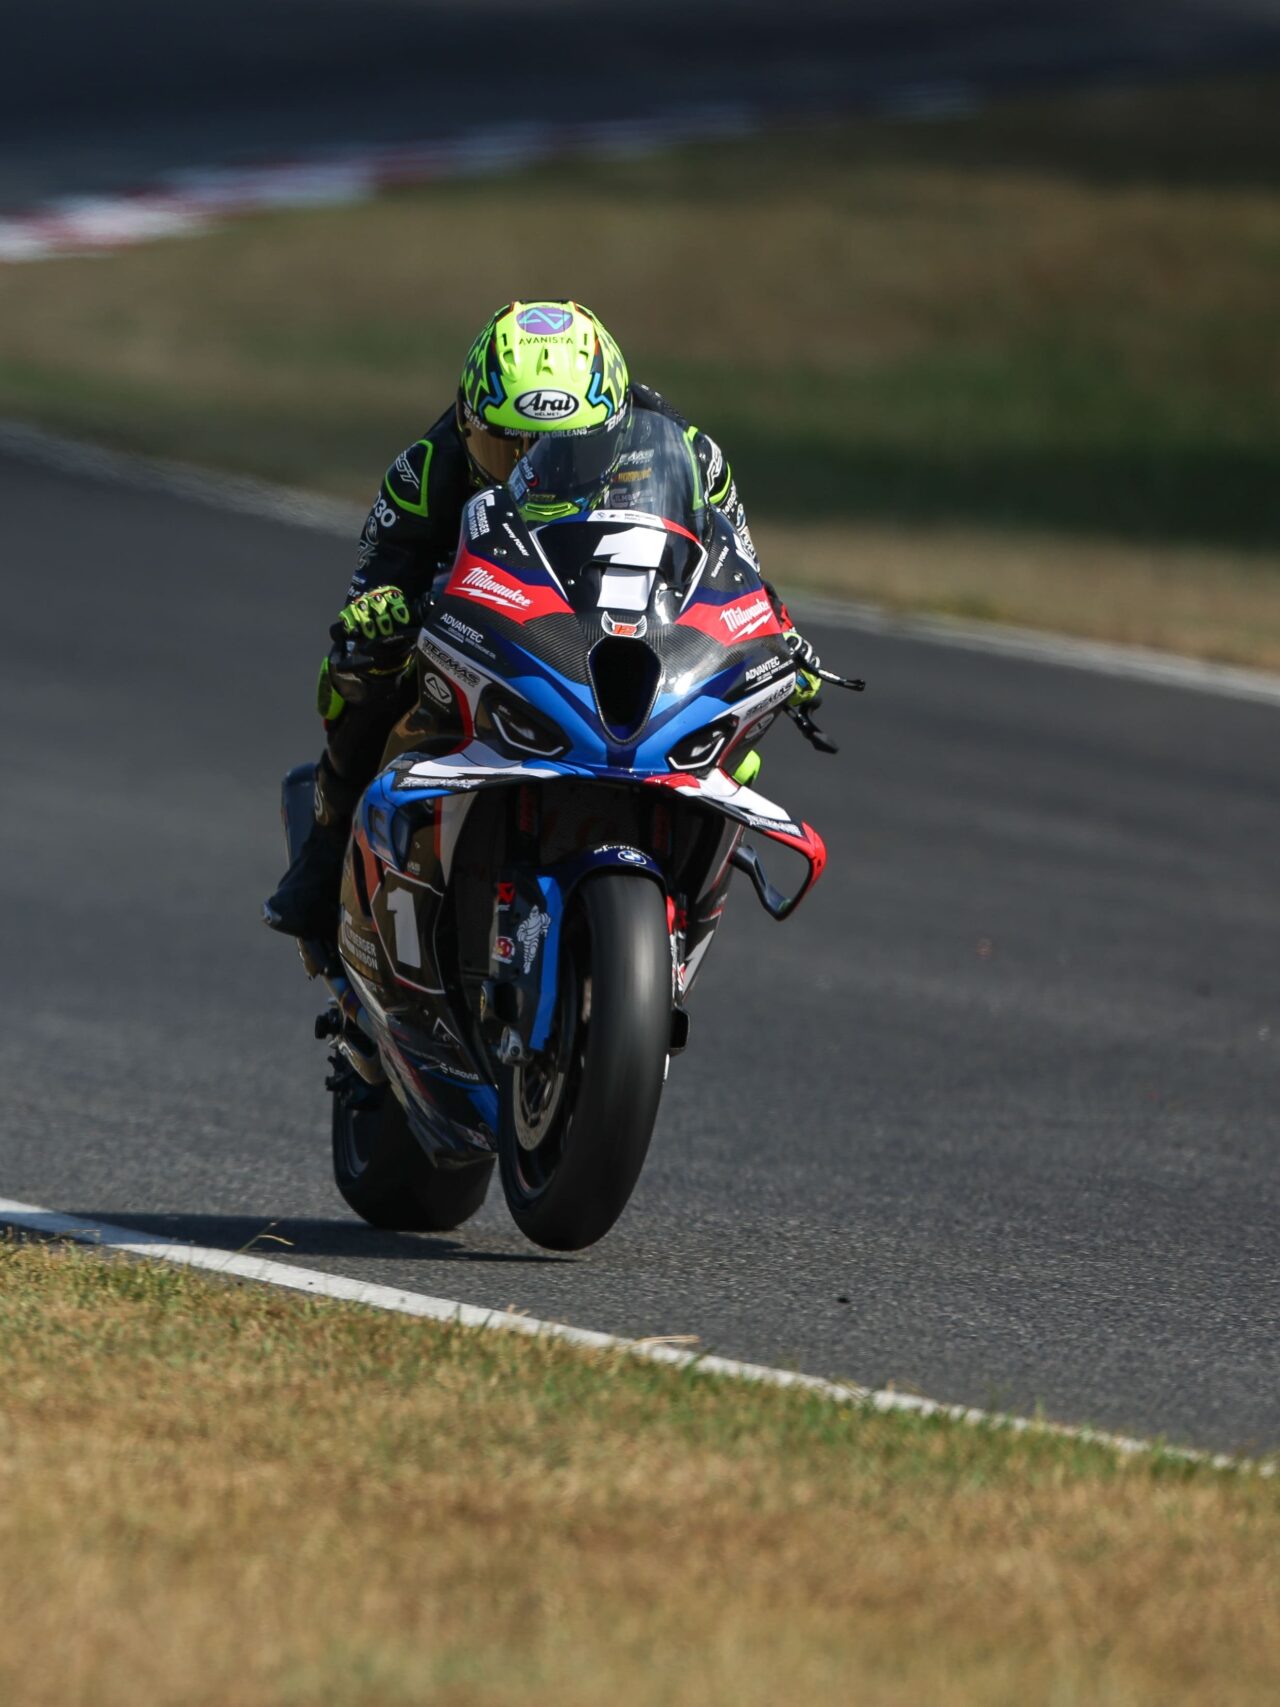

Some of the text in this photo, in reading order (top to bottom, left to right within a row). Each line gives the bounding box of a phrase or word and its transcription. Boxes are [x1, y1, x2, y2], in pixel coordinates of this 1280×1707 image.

[518, 336, 574, 345] AVANISTA
[522, 391, 571, 412] Arai
[551, 427, 588, 438] ORLEANS
[520, 456, 535, 481] Puig
[593, 526, 668, 611] 1
[461, 566, 533, 607] Milwaukee
[440, 612, 484, 643] ADVANTEC
[719, 598, 771, 633] Milwaukee
[745, 655, 780, 682] ADVANTEC
[387, 887, 422, 969] 1
